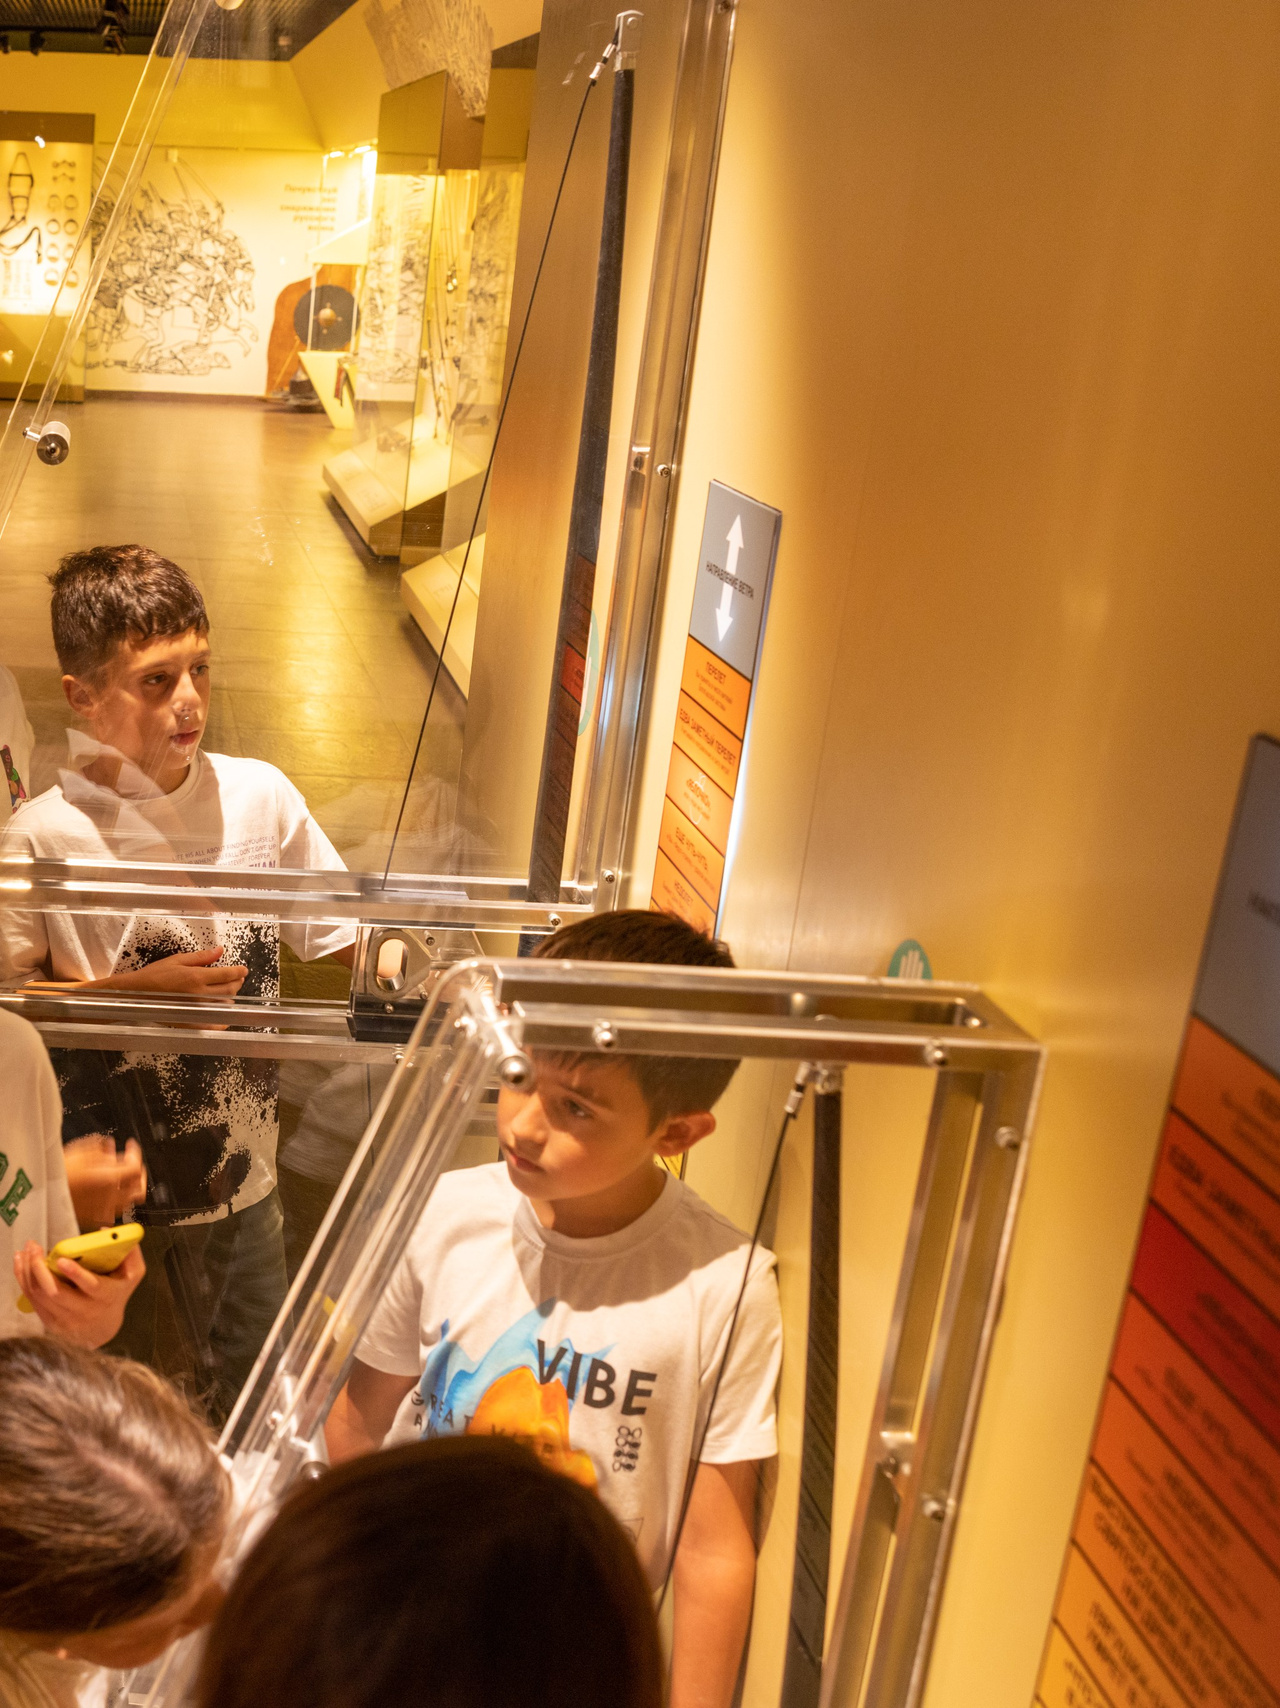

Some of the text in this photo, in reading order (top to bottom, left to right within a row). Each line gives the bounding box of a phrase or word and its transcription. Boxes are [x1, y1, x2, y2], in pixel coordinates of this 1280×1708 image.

[706, 560, 754, 600] НАПРАВЛЕНИЕ ВЕТРА
[706, 661, 726, 685] ПЕРЕЛЕТ
[206, 845, 225, 854] ABOUT
[248, 836, 275, 845] YOURSELF
[537, 1338, 658, 1417] VIBE
